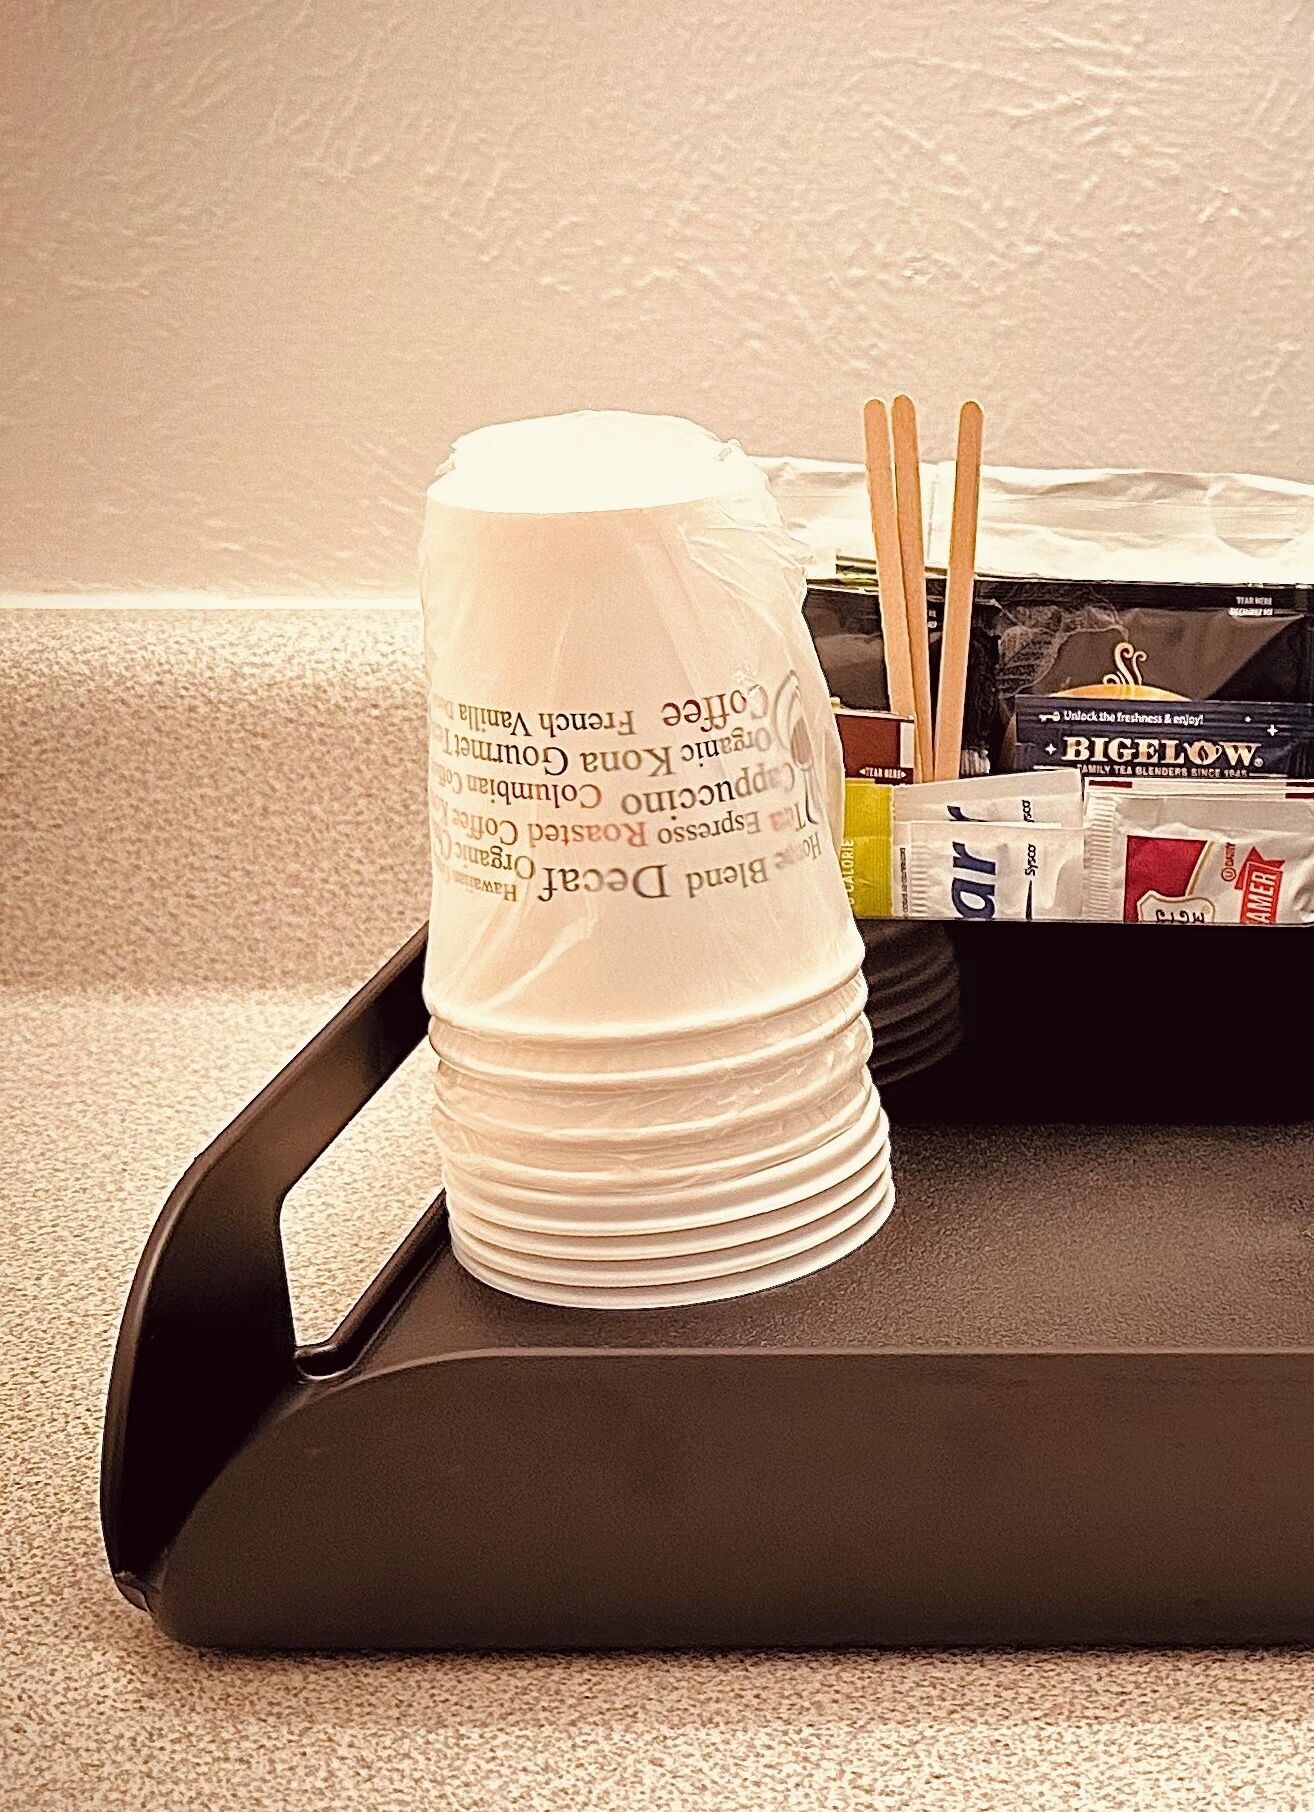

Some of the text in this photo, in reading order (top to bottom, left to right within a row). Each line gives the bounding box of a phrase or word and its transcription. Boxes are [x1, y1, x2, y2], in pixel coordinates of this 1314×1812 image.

[459, 703, 531, 736] Vanilla
[540, 709, 636, 738] French
[661, 685, 768, 732] Coffee
[1063, 710, 1204, 726] Unlock the freshness & enjoy!
[453, 734, 568, 776] Gourmet
[580, 745, 673, 777] Kona
[681, 726, 771, 766] Organic
[1061, 736, 1262, 767] BIGELOW
[1113, 764, 1133, 775] TEA
[1135, 765, 1188, 777] BLENDERS
[1191, 766, 1221, 778] SINCE
[466, 775, 603, 809] Columbian
[621, 761, 795, 820] Cappuccino
[452, 811, 518, 846] Coffee
[528, 821, 648, 848] Roasted
[657, 808, 760, 847] Espresso
[454, 843, 536, 879] Organic
[1025, 843, 1037, 877] Sysco
[538, 864, 668, 901] Decaf
[685, 857, 768, 898] Blend
